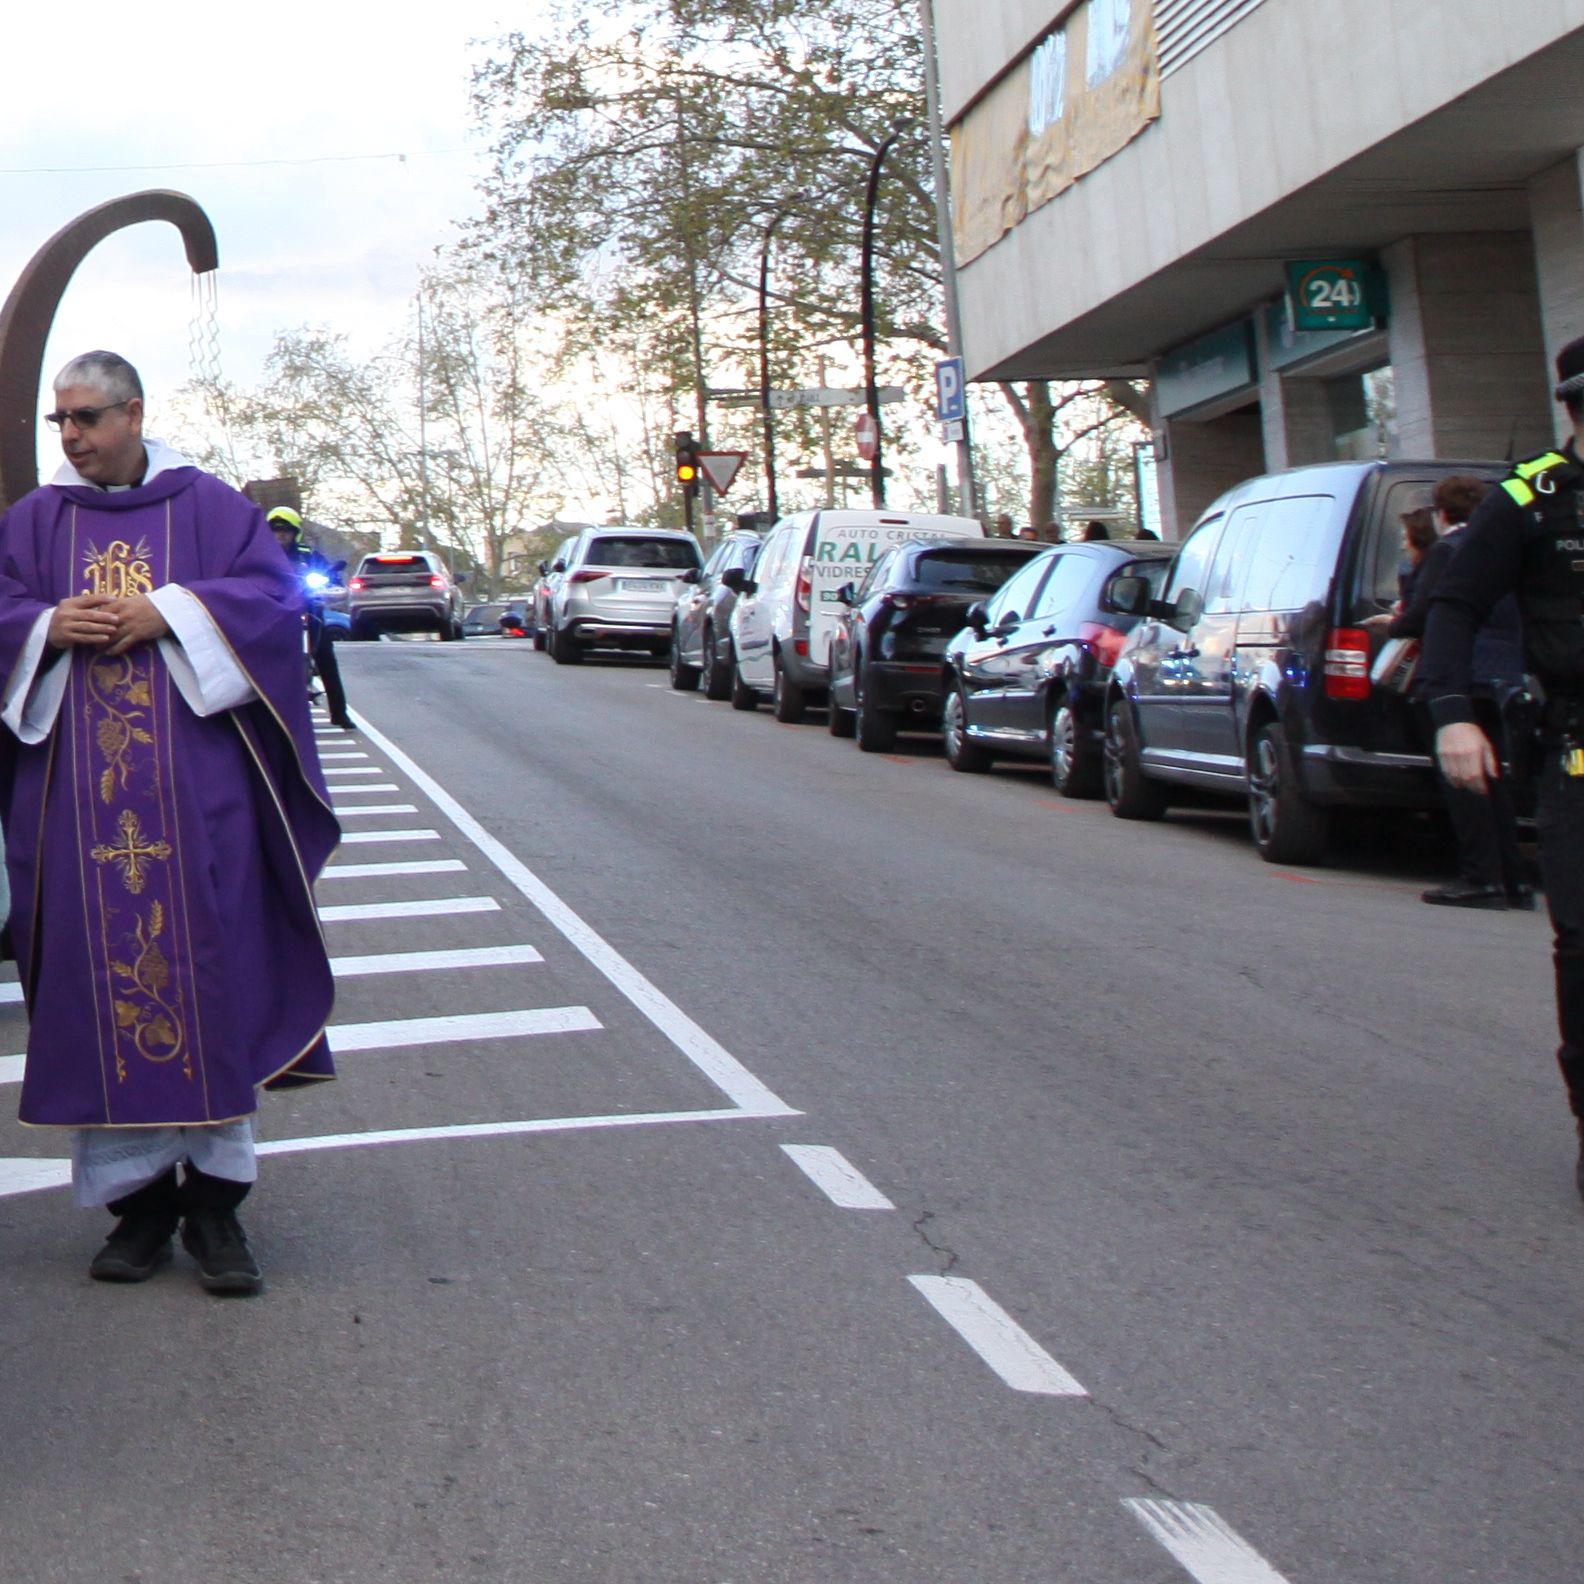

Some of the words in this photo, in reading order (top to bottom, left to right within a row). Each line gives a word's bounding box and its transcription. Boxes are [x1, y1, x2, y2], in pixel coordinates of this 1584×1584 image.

[939, 366, 957, 414] P
[838, 529, 879, 539] AUTO
[1556, 539, 1584, 551] POL
